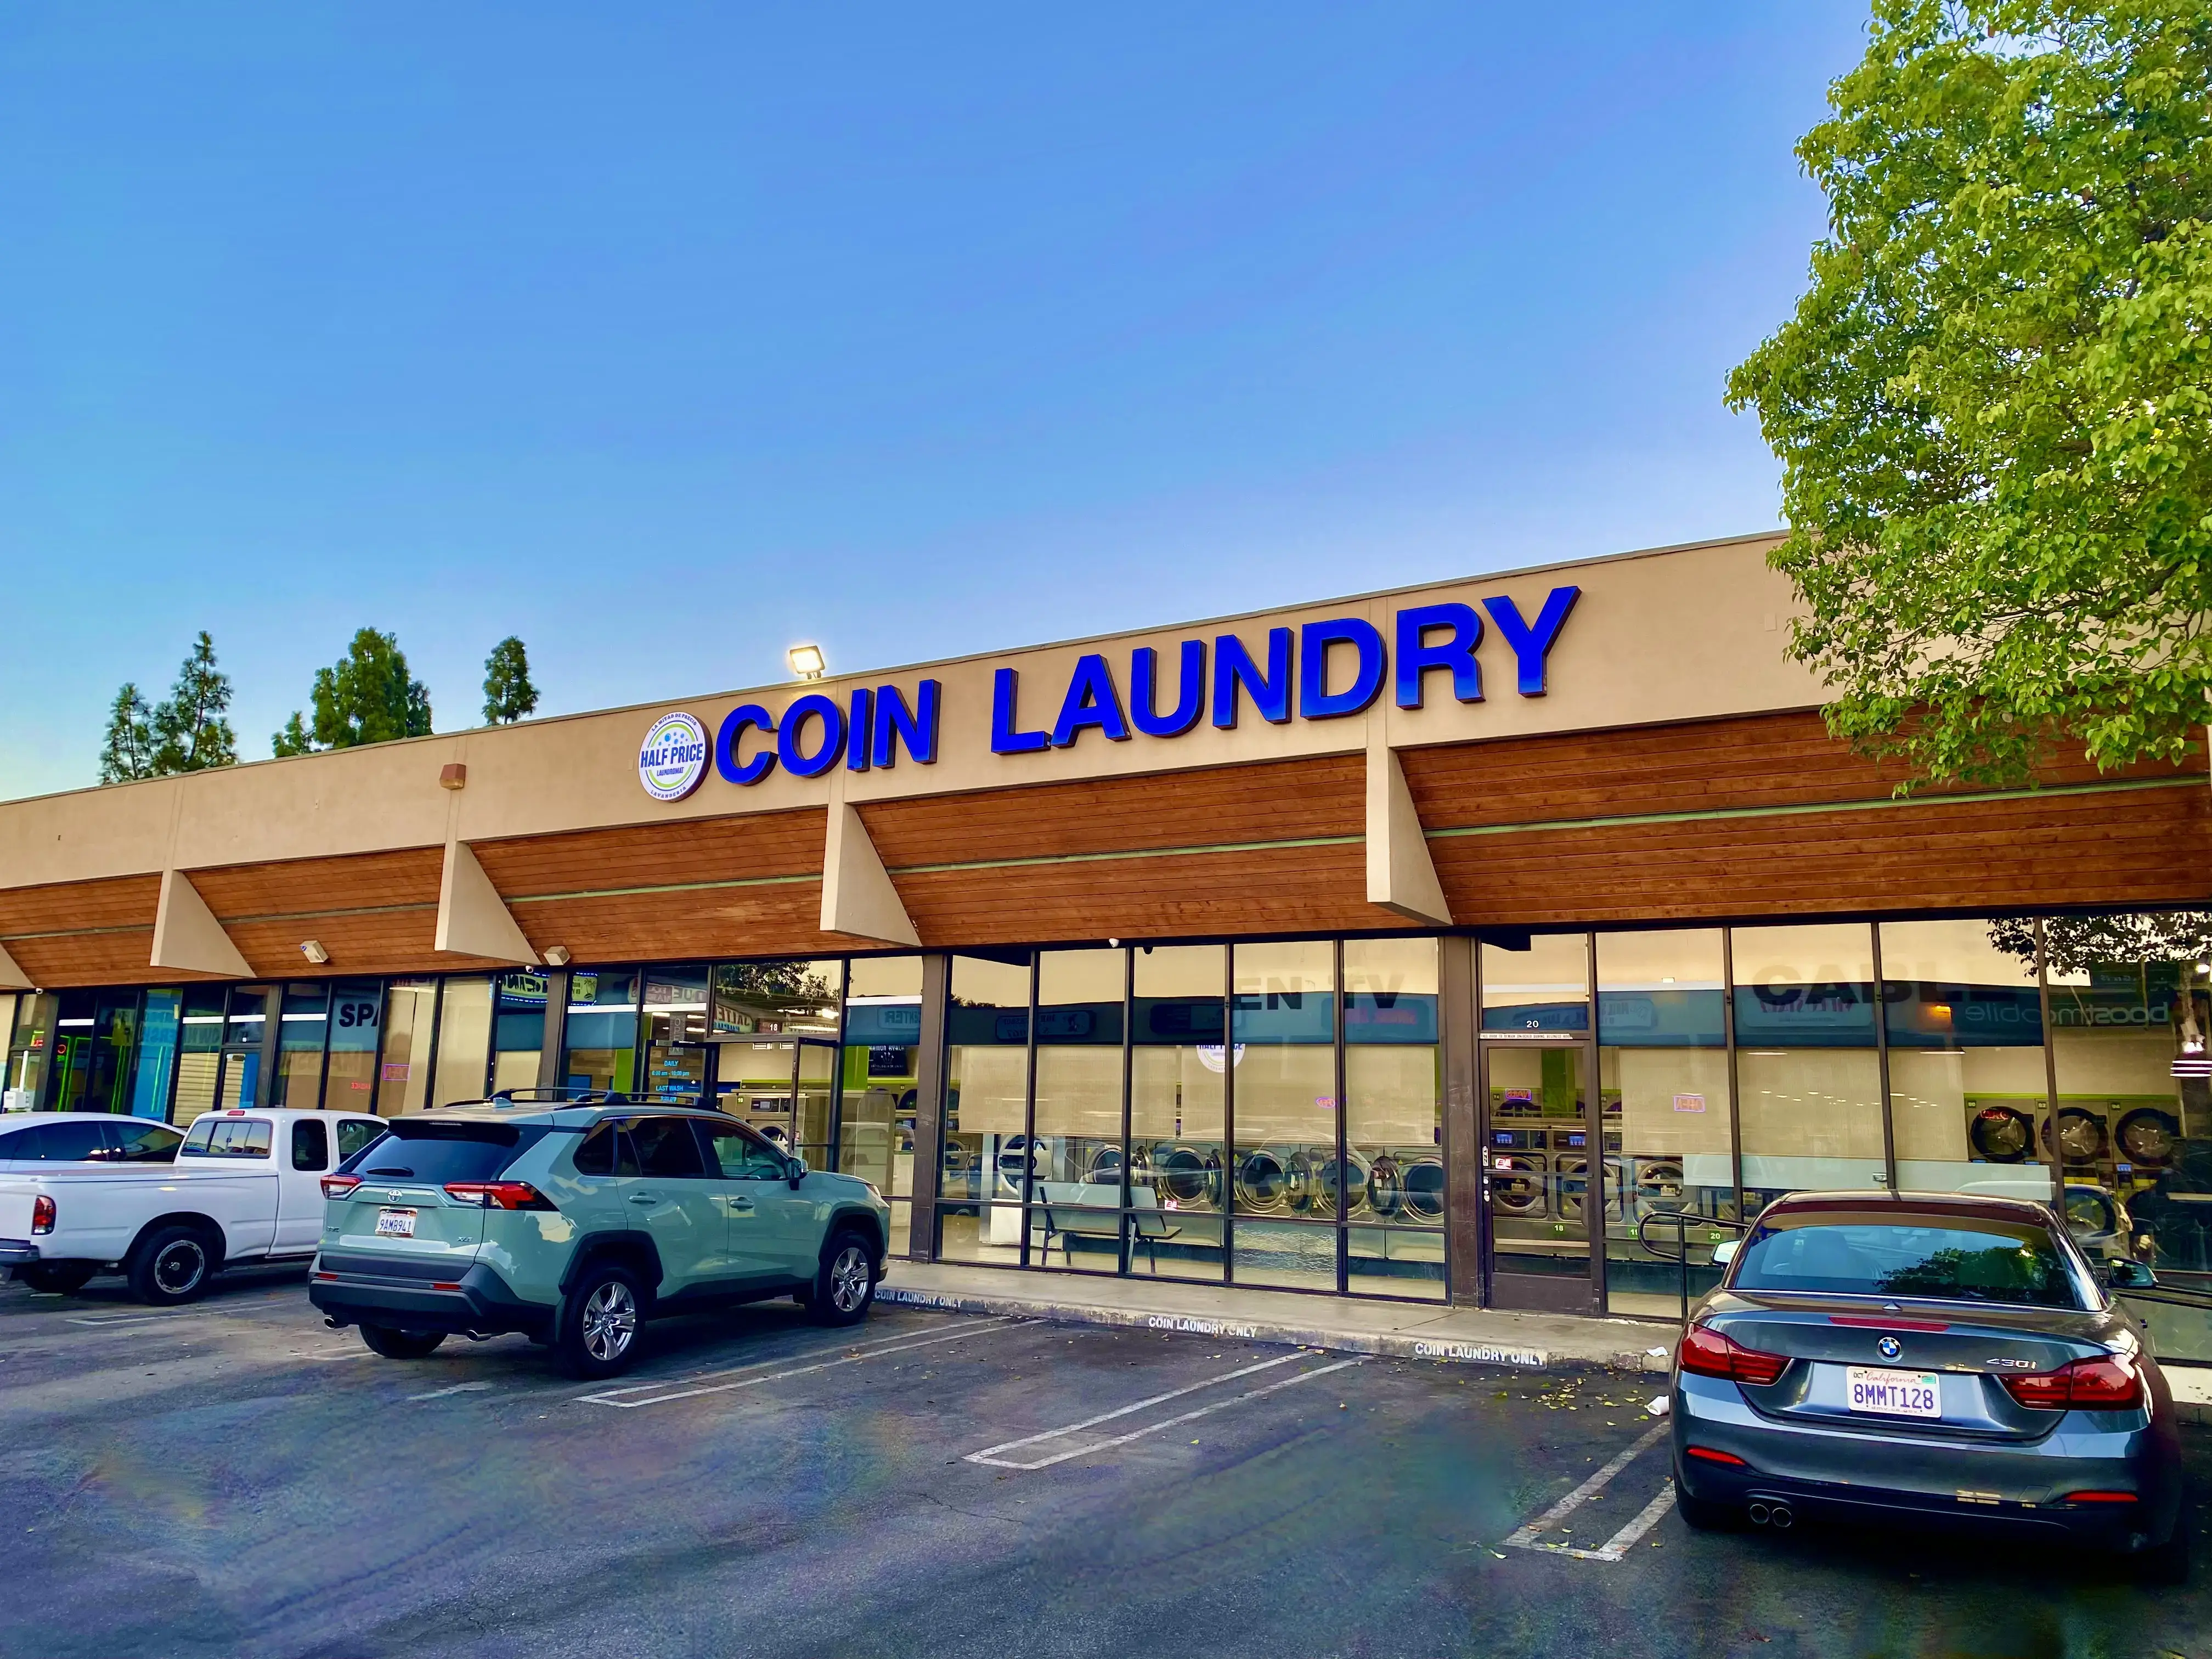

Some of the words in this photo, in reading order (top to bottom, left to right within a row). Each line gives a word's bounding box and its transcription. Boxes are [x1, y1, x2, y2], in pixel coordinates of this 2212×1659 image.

[716, 679, 940, 786] COIN
[991, 585, 1581, 755] LAUNDRY
[658, 714, 674, 725] MITAD
[682, 714, 697, 726] PRECIO
[640, 748, 668, 768] HALF
[670, 743, 703, 764] PRICE
[657, 767, 684, 776] LAUNDROMAT
[1526, 1020, 1539, 1028] 20
[379, 1219, 411, 1233] 9AMB941
[874, 1290, 895, 1301] COIN
[897, 1291, 938, 1305] LAUNDRY
[939, 1296, 963, 1308] ONLY
[1148, 1316, 1173, 1329] COIN
[1176, 1319, 1226, 1335] LAUNDRY
[1415, 1342, 1444, 1356] COIN
[1448, 1345, 1508, 1362] LAUNDRY
[1510, 1351, 1547, 1365] ONLY
[1866, 1372, 1922, 1385] California
[1854, 1384, 1933, 1409] 8MMT128
